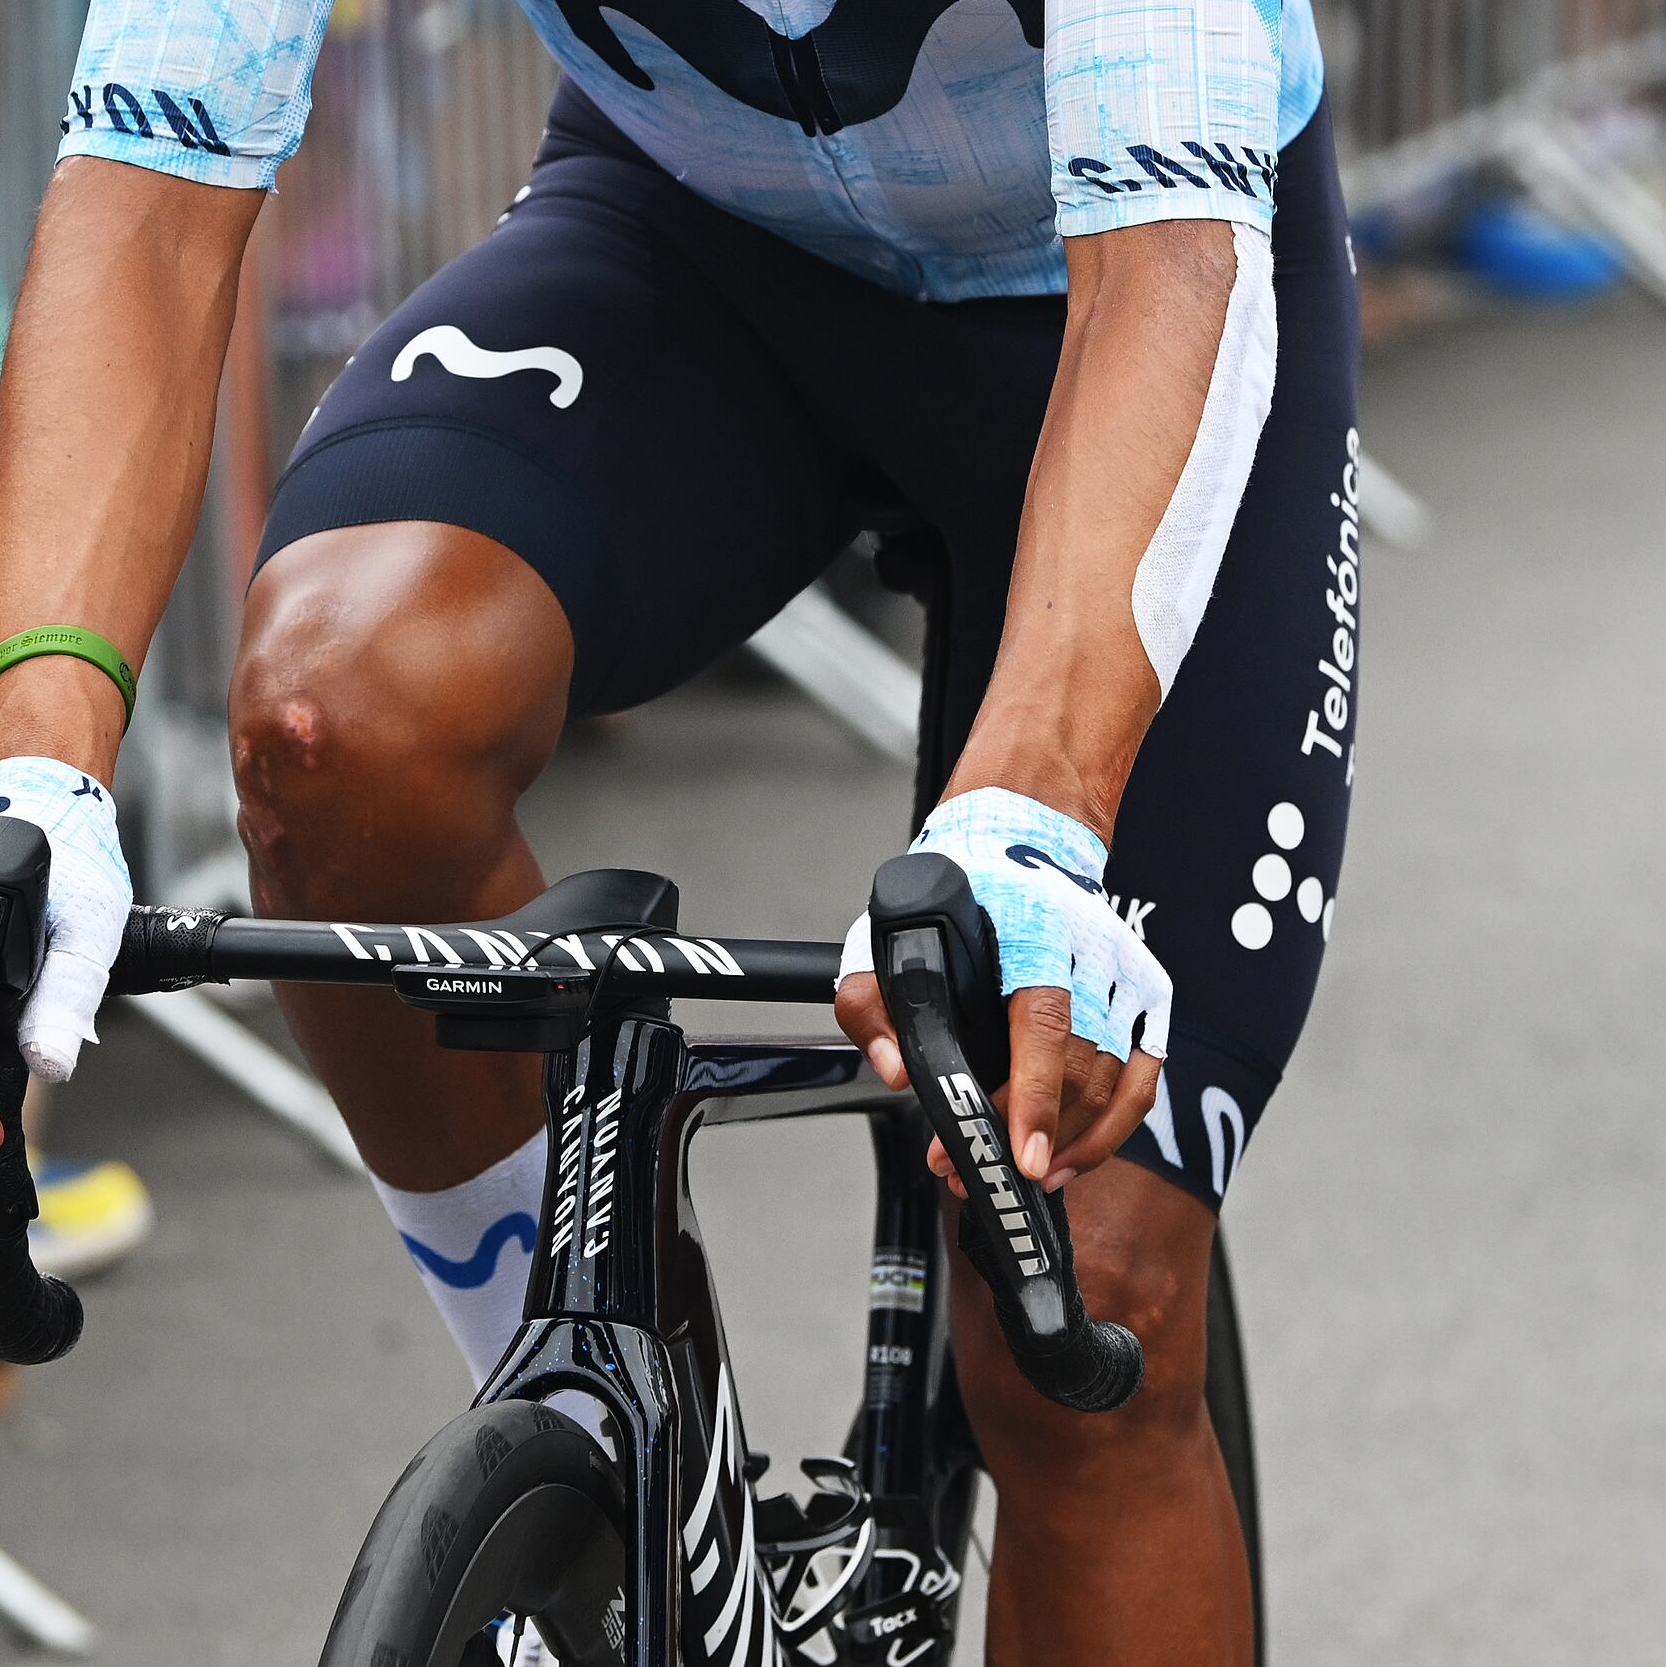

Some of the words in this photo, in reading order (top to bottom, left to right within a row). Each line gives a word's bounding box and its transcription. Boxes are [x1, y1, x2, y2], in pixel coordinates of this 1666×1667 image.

[59, 83, 232, 158] YON
[20, 633, 84, 650] Siempre
[1300, 427, 1360, 759] Telefónica
[330, 922, 745, 977] CANYON
[425, 978, 503, 995] GARMIN
[550, 1084, 586, 1259] CANYON
[583, 1087, 623, 1259] CANYON
[937, 1071, 1051, 1278] SRAM
